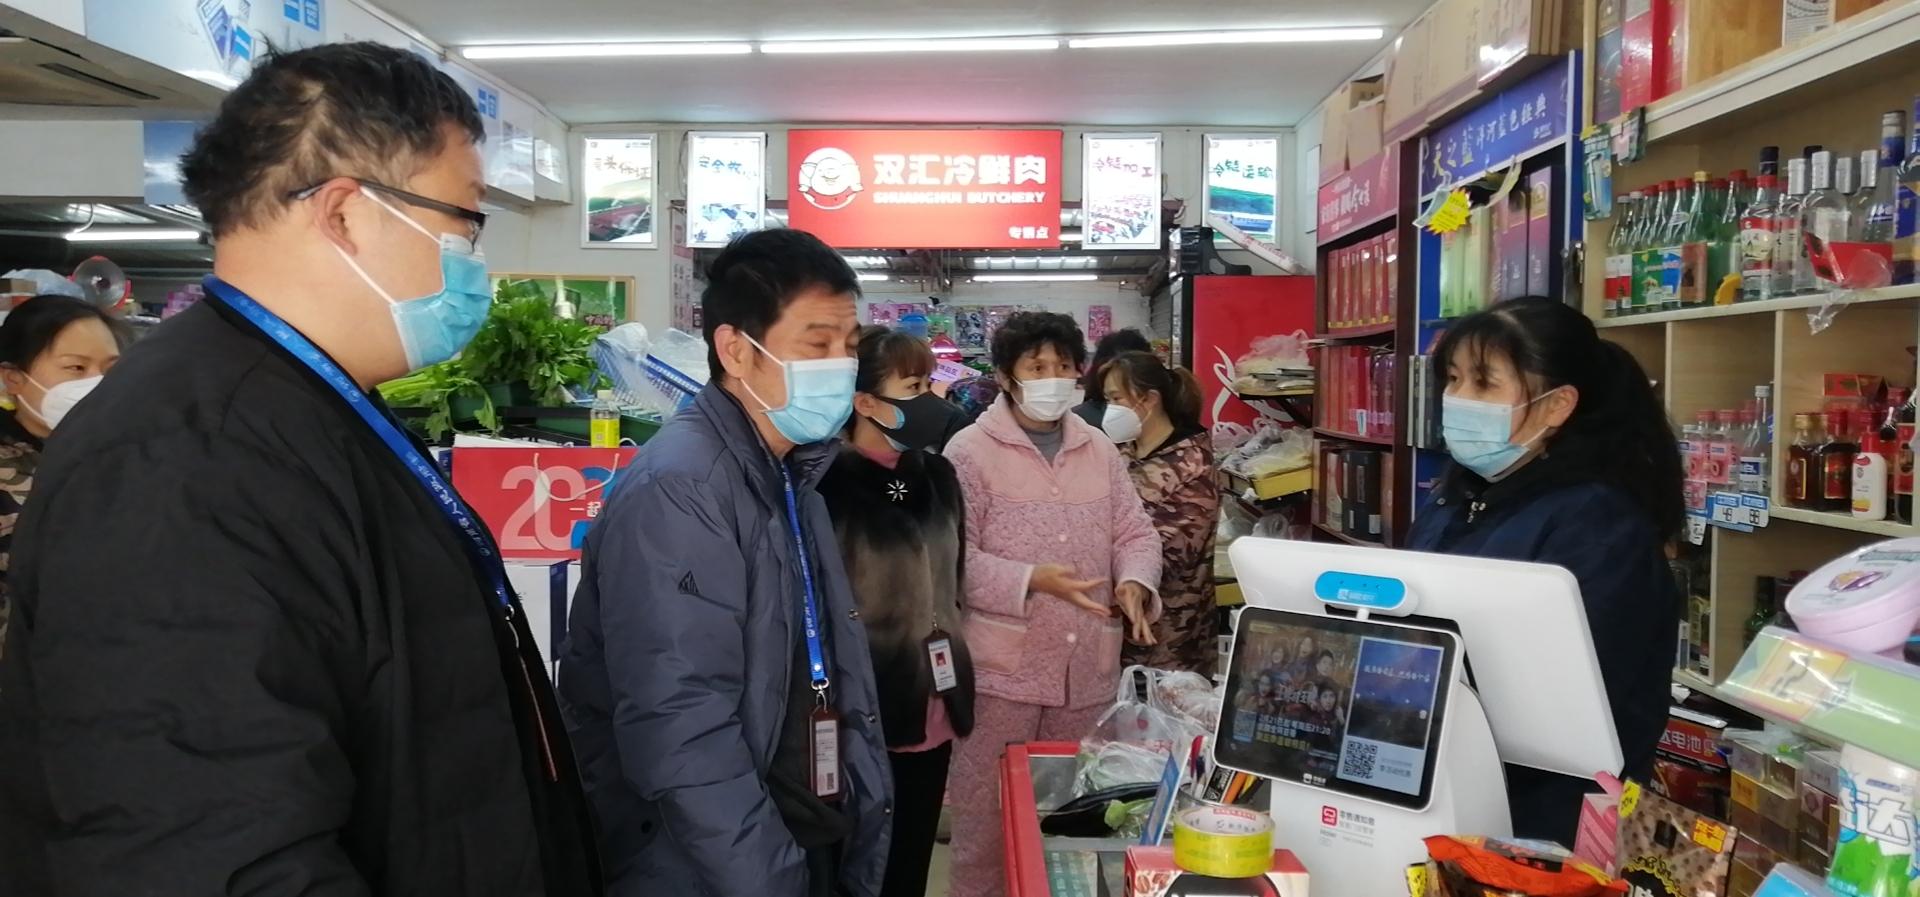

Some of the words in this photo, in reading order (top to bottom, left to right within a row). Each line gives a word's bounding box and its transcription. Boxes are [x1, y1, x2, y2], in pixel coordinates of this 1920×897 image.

[873, 154, 1047, 186] 双汇冷鲜肉
[966, 192, 1047, 204] BUTCHERY
